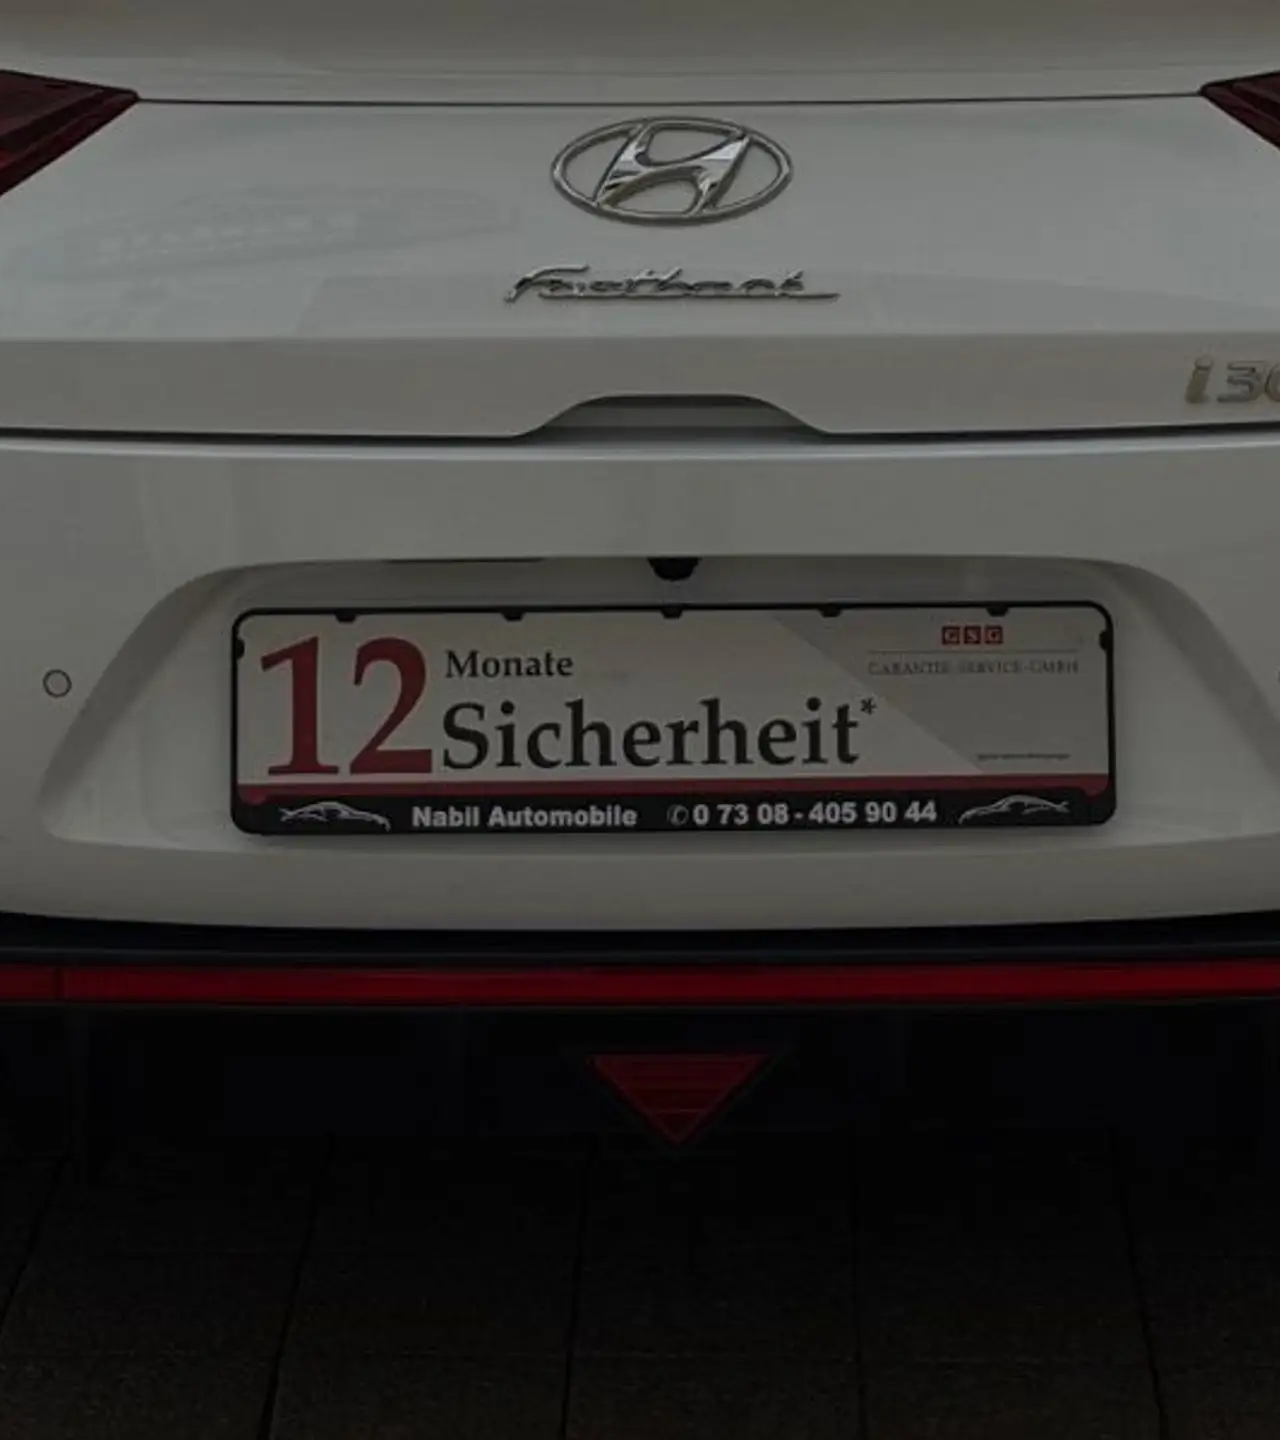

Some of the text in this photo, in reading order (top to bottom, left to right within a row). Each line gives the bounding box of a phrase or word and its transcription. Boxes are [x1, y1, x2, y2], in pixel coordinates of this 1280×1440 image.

[446, 650, 573, 677] Monate
[261, 636, 432, 775] 12
[413, 805, 637, 826] Nabil Automobile
[717, 803, 748, 825] 73
[758, 803, 789, 825] 08
[809, 801, 857, 824] 405
[865, 801, 897, 823] 90
[905, 800, 937, 823] 44
